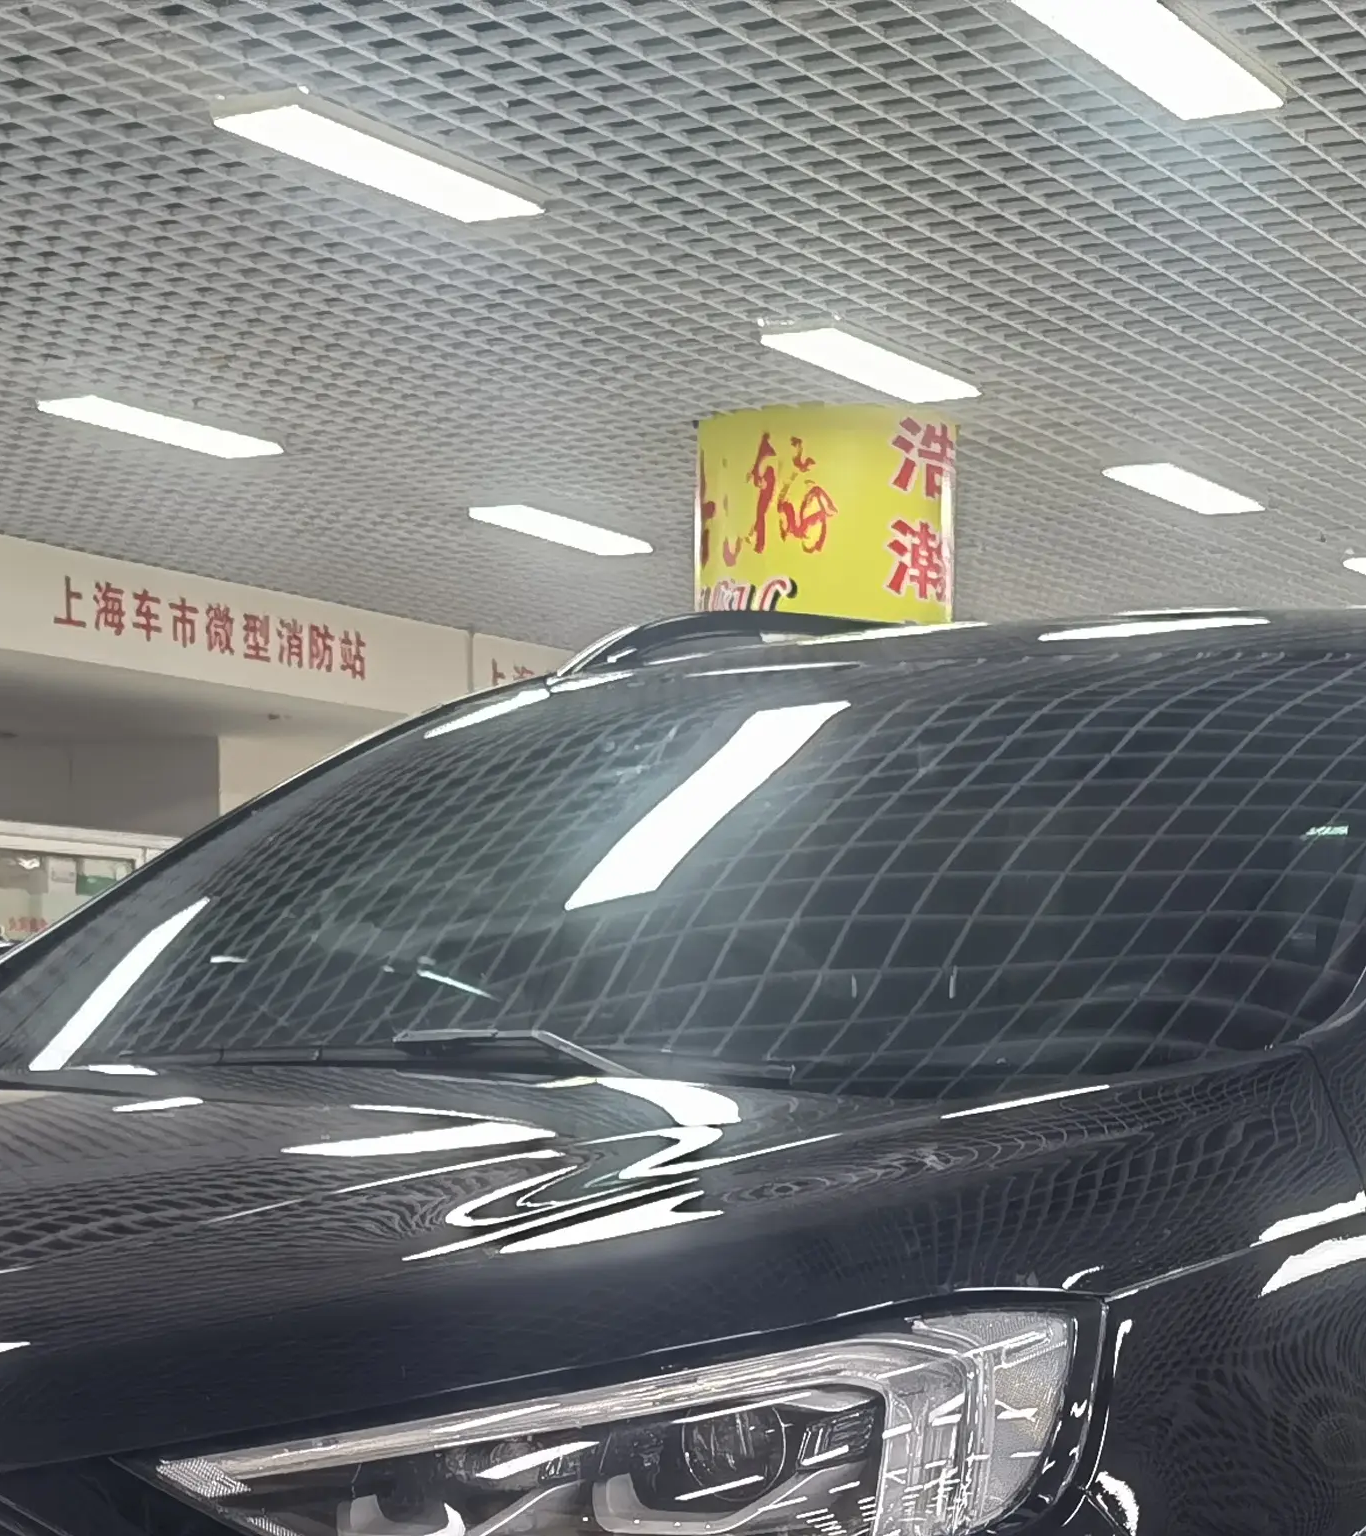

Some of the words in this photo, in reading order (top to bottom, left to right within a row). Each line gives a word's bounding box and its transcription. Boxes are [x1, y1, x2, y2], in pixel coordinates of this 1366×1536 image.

[53, 575, 367, 681] 上海车市微型消防站
